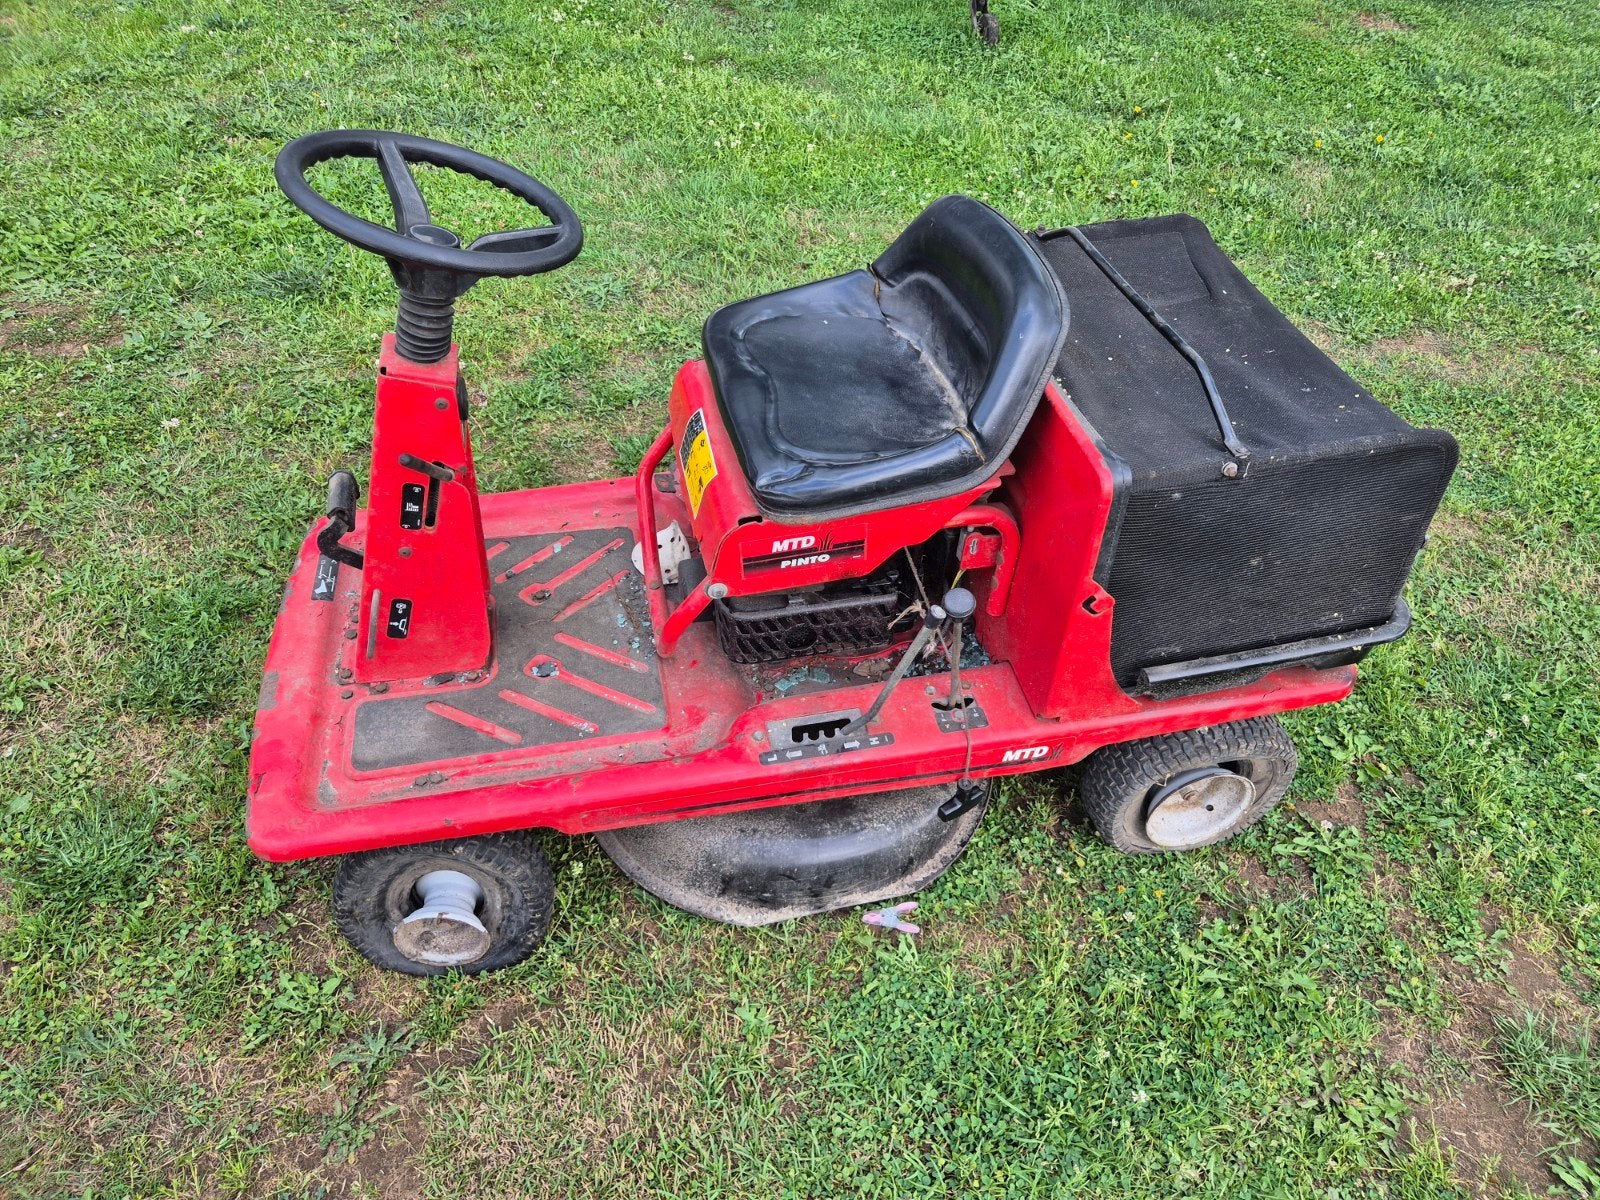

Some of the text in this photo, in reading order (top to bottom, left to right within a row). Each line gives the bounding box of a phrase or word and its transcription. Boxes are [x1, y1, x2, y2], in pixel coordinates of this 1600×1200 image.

[771, 535, 816, 553] MTD
[780, 554, 831, 569] PINTO
[1001, 745, 1050, 763] MTD
